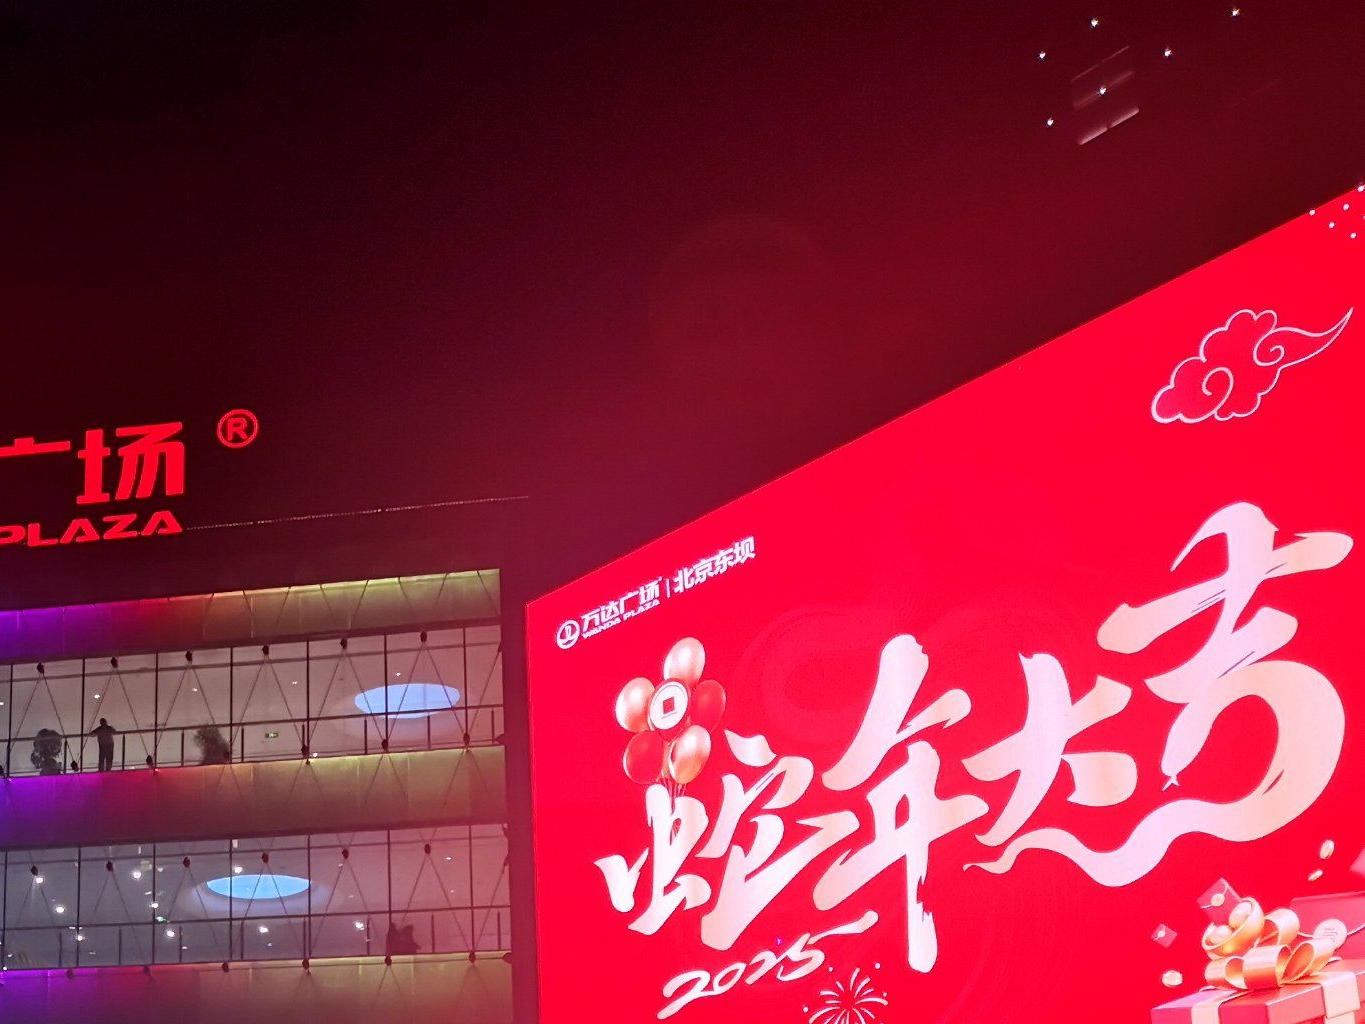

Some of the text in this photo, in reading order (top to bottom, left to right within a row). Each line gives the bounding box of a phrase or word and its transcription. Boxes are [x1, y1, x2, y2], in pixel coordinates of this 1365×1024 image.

[581, 536, 756, 632] 万达广场 北京东坝
[582, 599, 660, 639] WANDA PLAZA
[594, 501, 1354, 974] 蛇年大吉
[656, 911, 880, 1021] 2025
